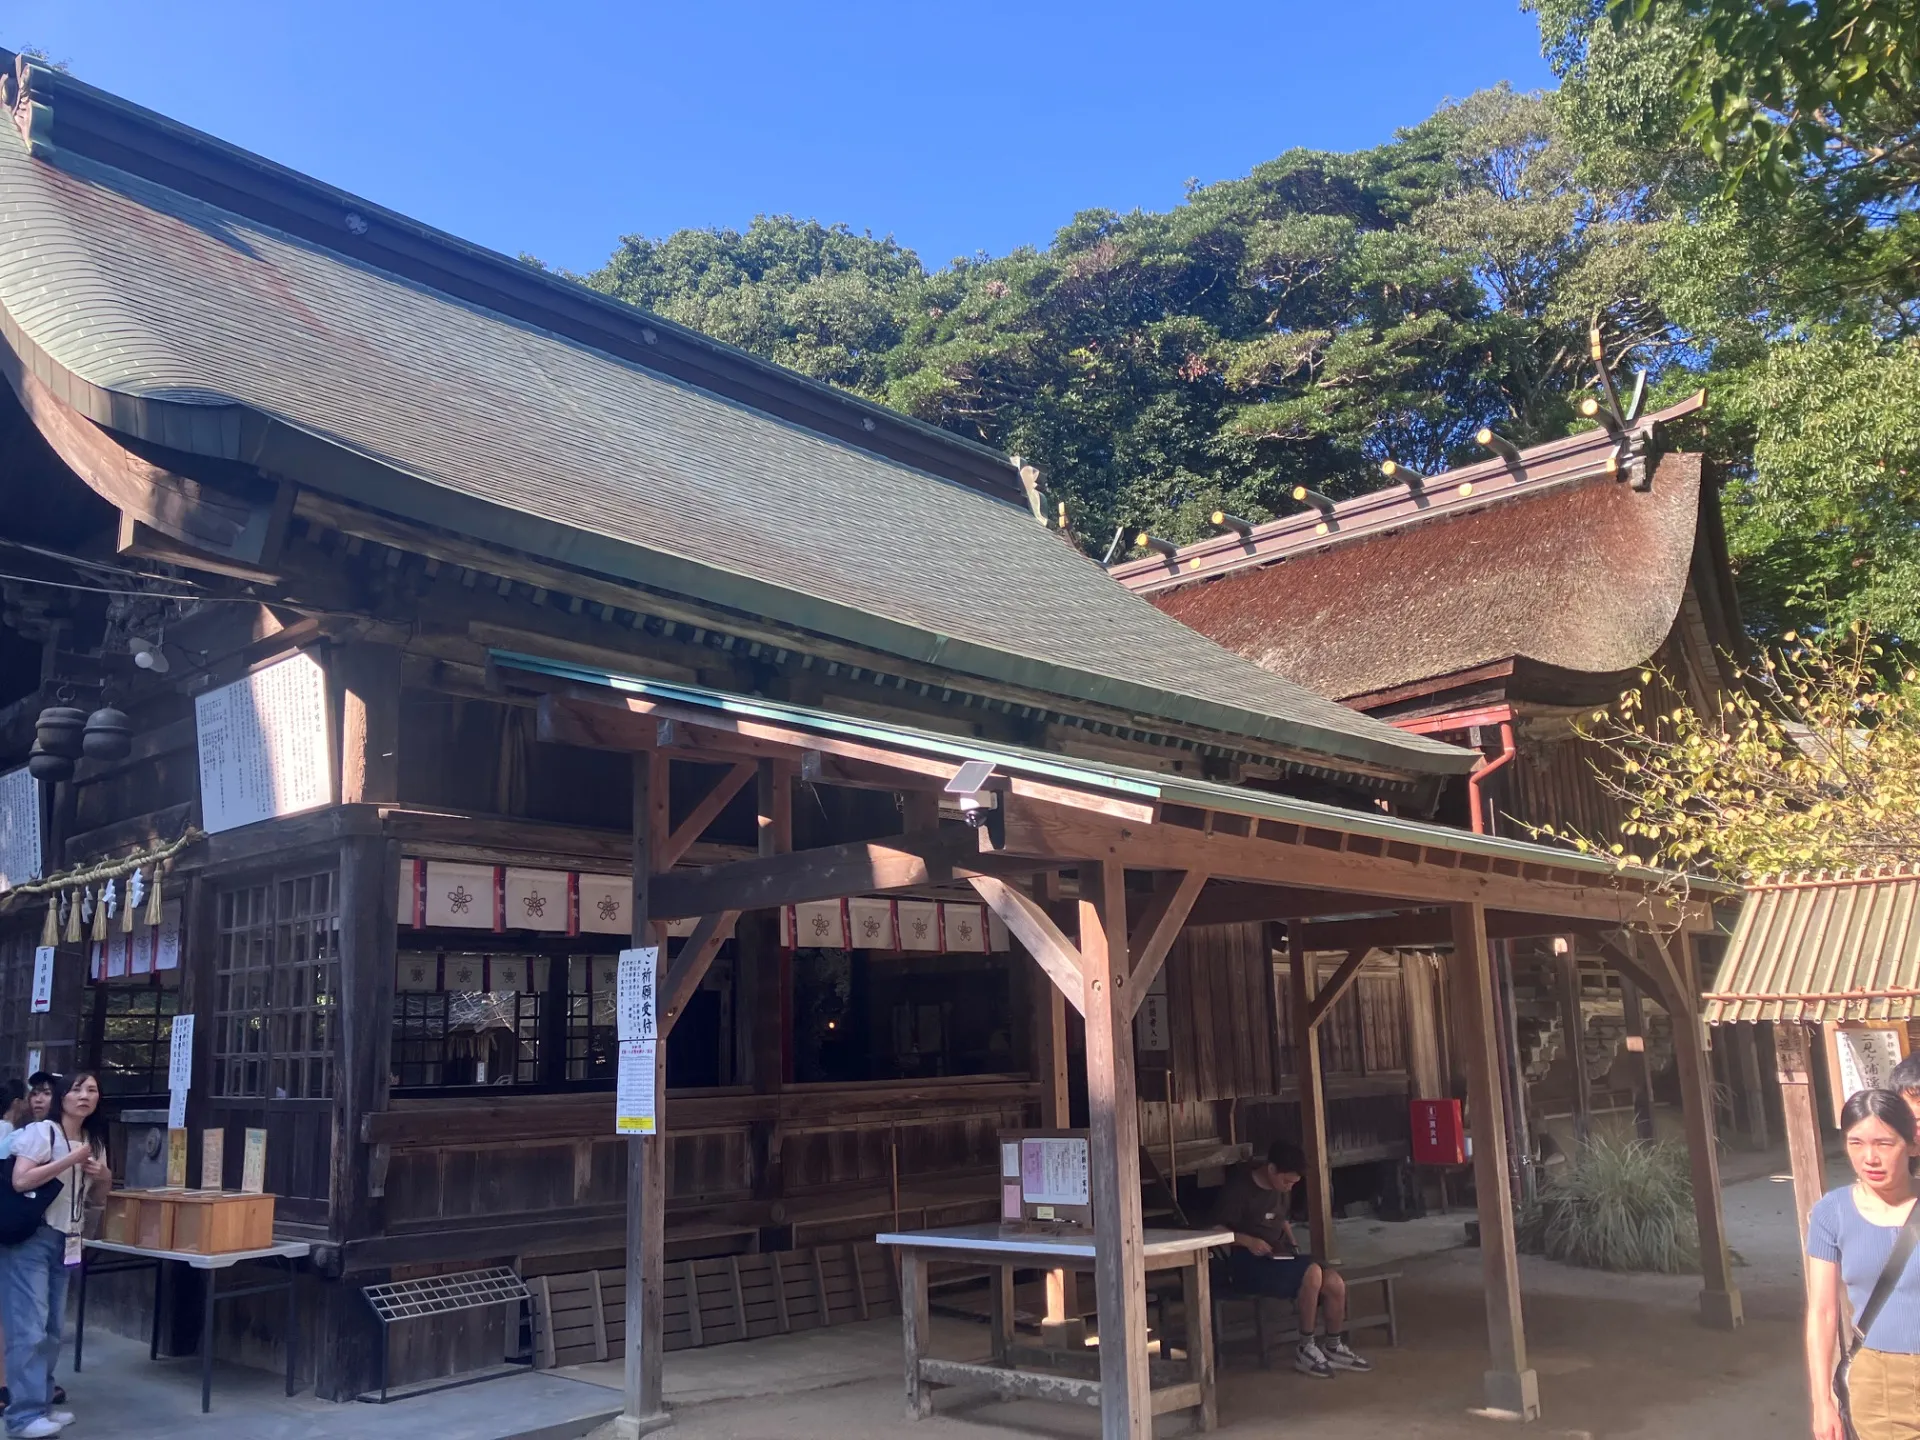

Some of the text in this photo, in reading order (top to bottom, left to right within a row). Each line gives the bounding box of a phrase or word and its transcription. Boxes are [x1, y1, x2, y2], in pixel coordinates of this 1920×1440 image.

[641, 951, 654, 1035] ご祈願受付
